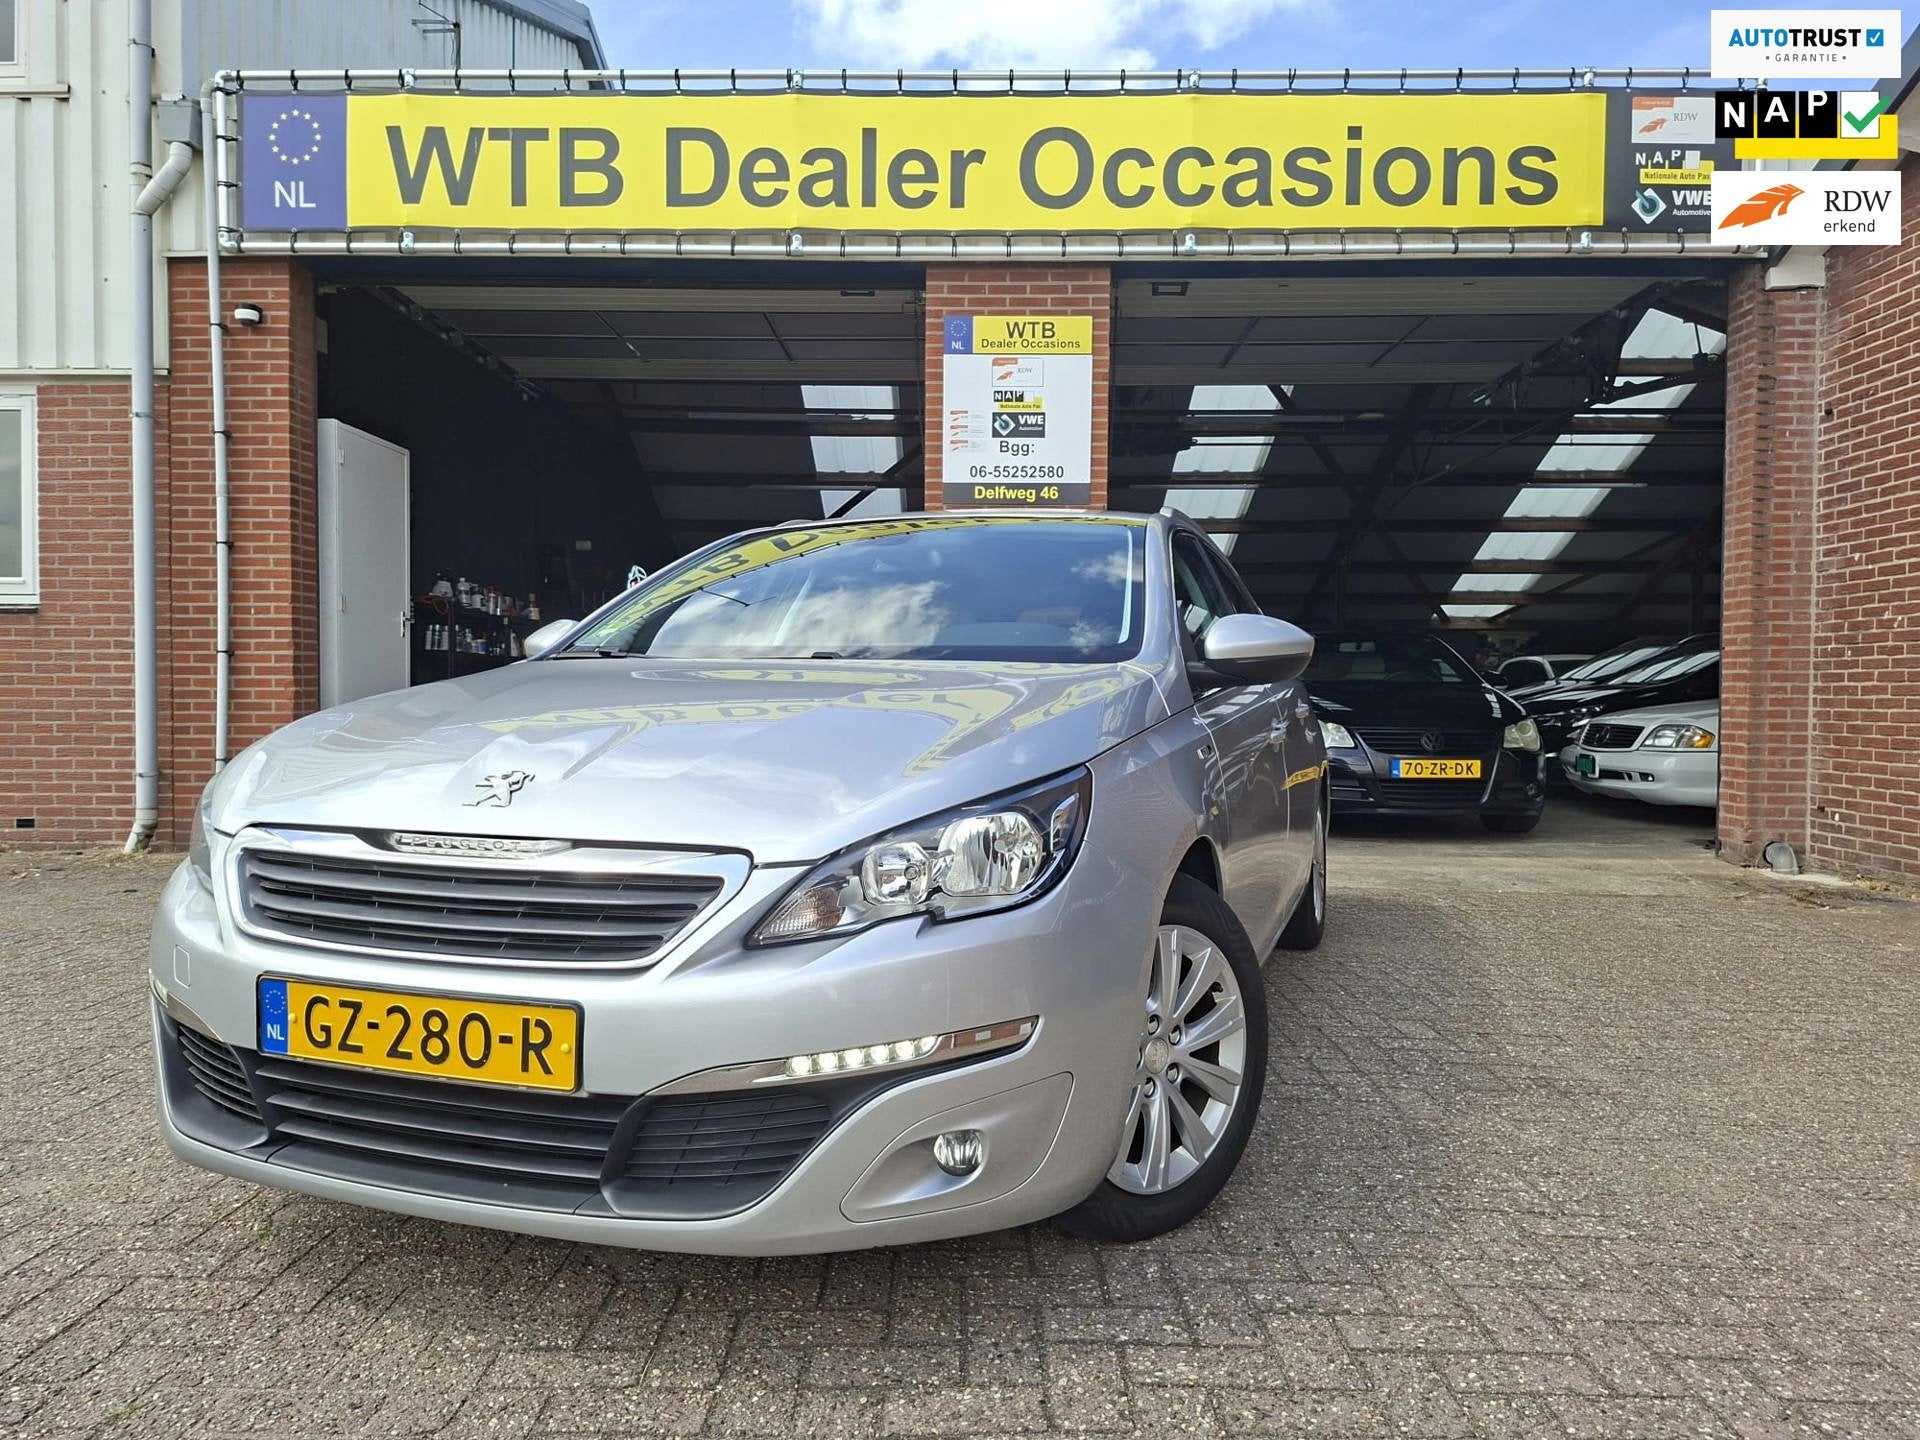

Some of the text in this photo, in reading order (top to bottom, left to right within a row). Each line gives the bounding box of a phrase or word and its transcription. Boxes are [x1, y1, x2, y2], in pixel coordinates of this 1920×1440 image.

[1673, 112, 1698, 122] RDW
[385, 125, 1559, 210] WTB Dealer Occasions
[1644, 171, 1678, 180] Nationale
[1679, 171, 1696, 180] Auto
[274, 181, 317, 210] NL
[1006, 321, 1056, 339] WTB
[951, 341, 965, 350] NL
[981, 338, 1081, 349] Dealer Occasions
[1018, 415, 1044, 425] VWE
[999, 440, 1035, 456] Bgg:
[969, 465, 1064, 479] 06-55252580
[974, 486, 1059, 502] Delfweg 46
[1404, 762, 1474, 776] 70-ZR-DK
[411, 836, 521, 853] PEUGEOT
[266, 1022, 285, 1040] NL
[303, 994, 554, 1075] GZ-280-R
